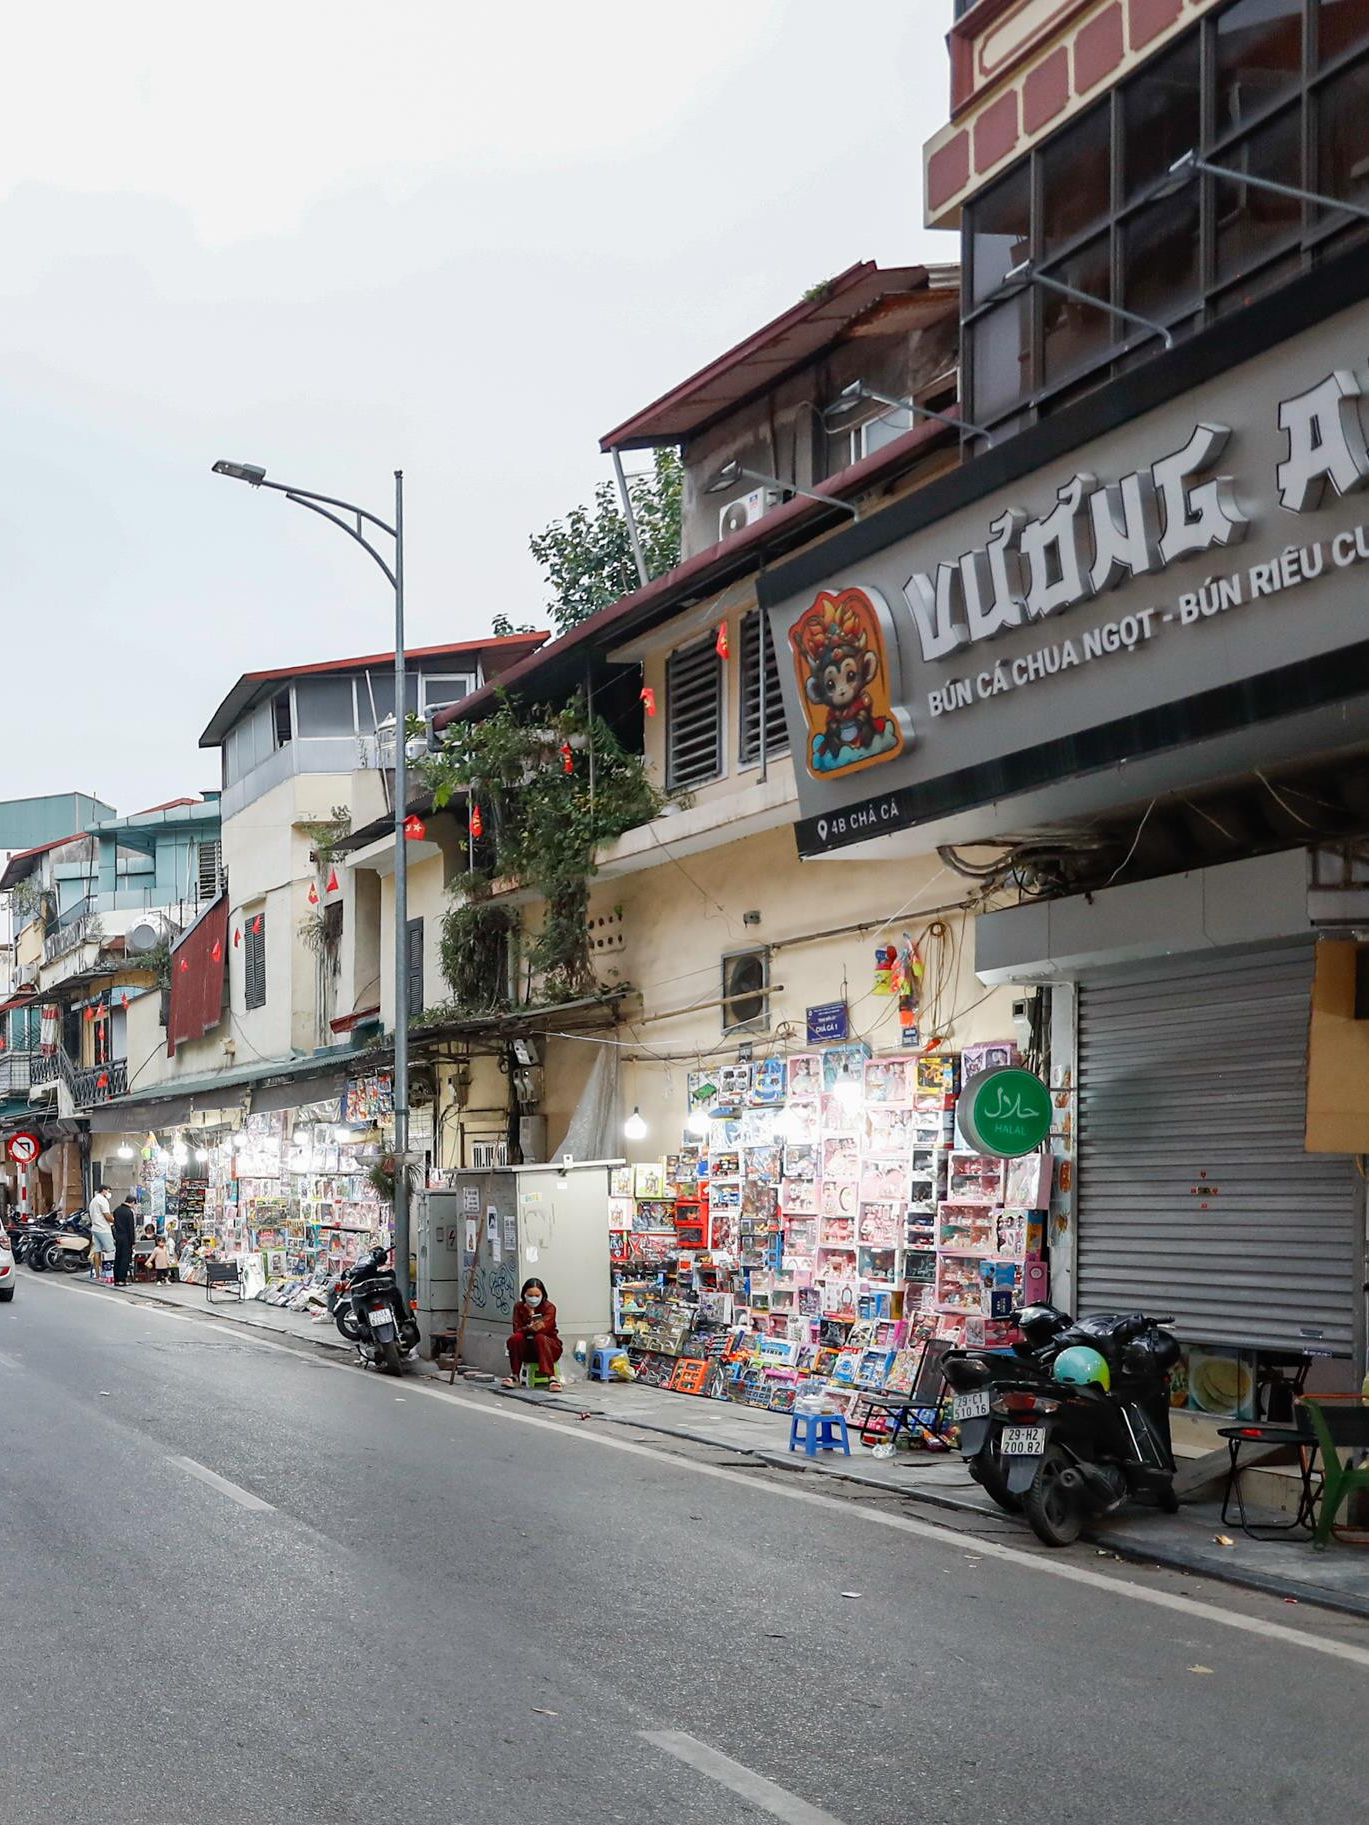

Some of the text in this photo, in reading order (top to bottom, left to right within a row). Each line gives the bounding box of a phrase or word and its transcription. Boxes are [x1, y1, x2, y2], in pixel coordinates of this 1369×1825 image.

[903, 371, 1369, 662] VƯƠNG A
[928, 678, 974, 719] BÚN
[976, 662, 1009, 697] CÁ
[1011, 641, 1080, 693] CHUA
[1083, 608, 1157, 654] NGỌT
[1178, 576, 1243, 622] BÚN
[1249, 545, 1324, 600] RIÊU
[831, 798, 899, 834] 4B CHẢ CÁ
[984, 1086, 1040, 1119] حلال
[994, 1123, 1027, 1136] HALAL
[957, 1393, 983, 1408] 29-C1
[954, 1404, 988, 1419] 510.16
[1008, 1428, 1039, 1441] 29-H2
[1003, 1441, 1042, 1454] 200.82
